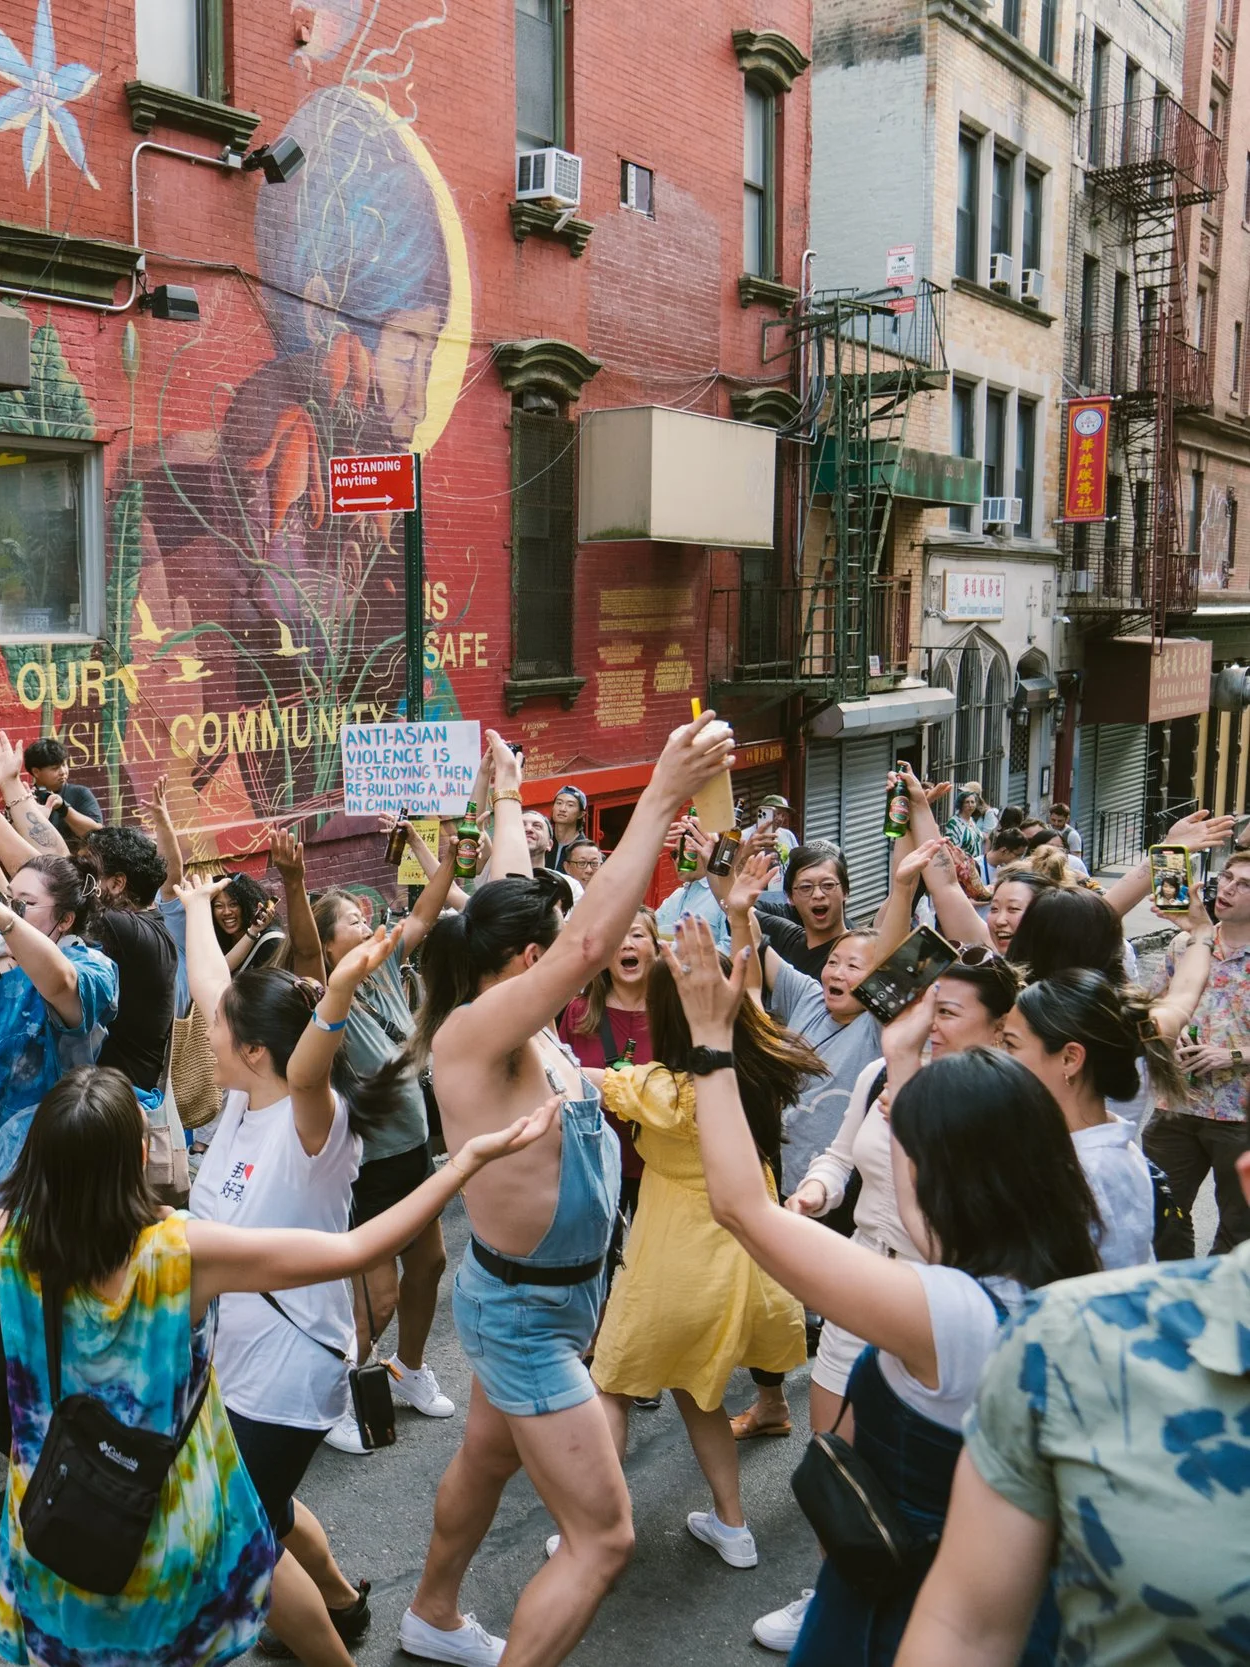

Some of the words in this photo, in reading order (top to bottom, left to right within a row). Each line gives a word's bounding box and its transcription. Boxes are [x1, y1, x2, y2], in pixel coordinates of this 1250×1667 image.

[333, 463, 349, 474] NO
[350, 460, 401, 473] STANDING
[334, 475, 378, 488] Anytime
[424, 582, 449, 620] IS
[424, 631, 489, 669] SAFE
[16, 660, 107, 710] OUR
[50, 716, 159, 769] ASIAN
[170, 702, 388, 759] COMMUNITY
[346, 726, 447, 748] ANTI-ASIAN
[346, 748, 423, 765] VIOLENCE
[433, 747, 450, 762] IS
[345, 765, 430, 780] DESTROYING
[436, 764, 472, 780] THEN
[346, 782, 425, 796] RE-BUILDING
[428, 782, 437, 795] A
[440, 782, 470, 796] JAIL
[347, 800, 362, 812] IN
[365, 799, 440, 812] CHINATOWN
[107, 1445, 139, 1469] Columbia
